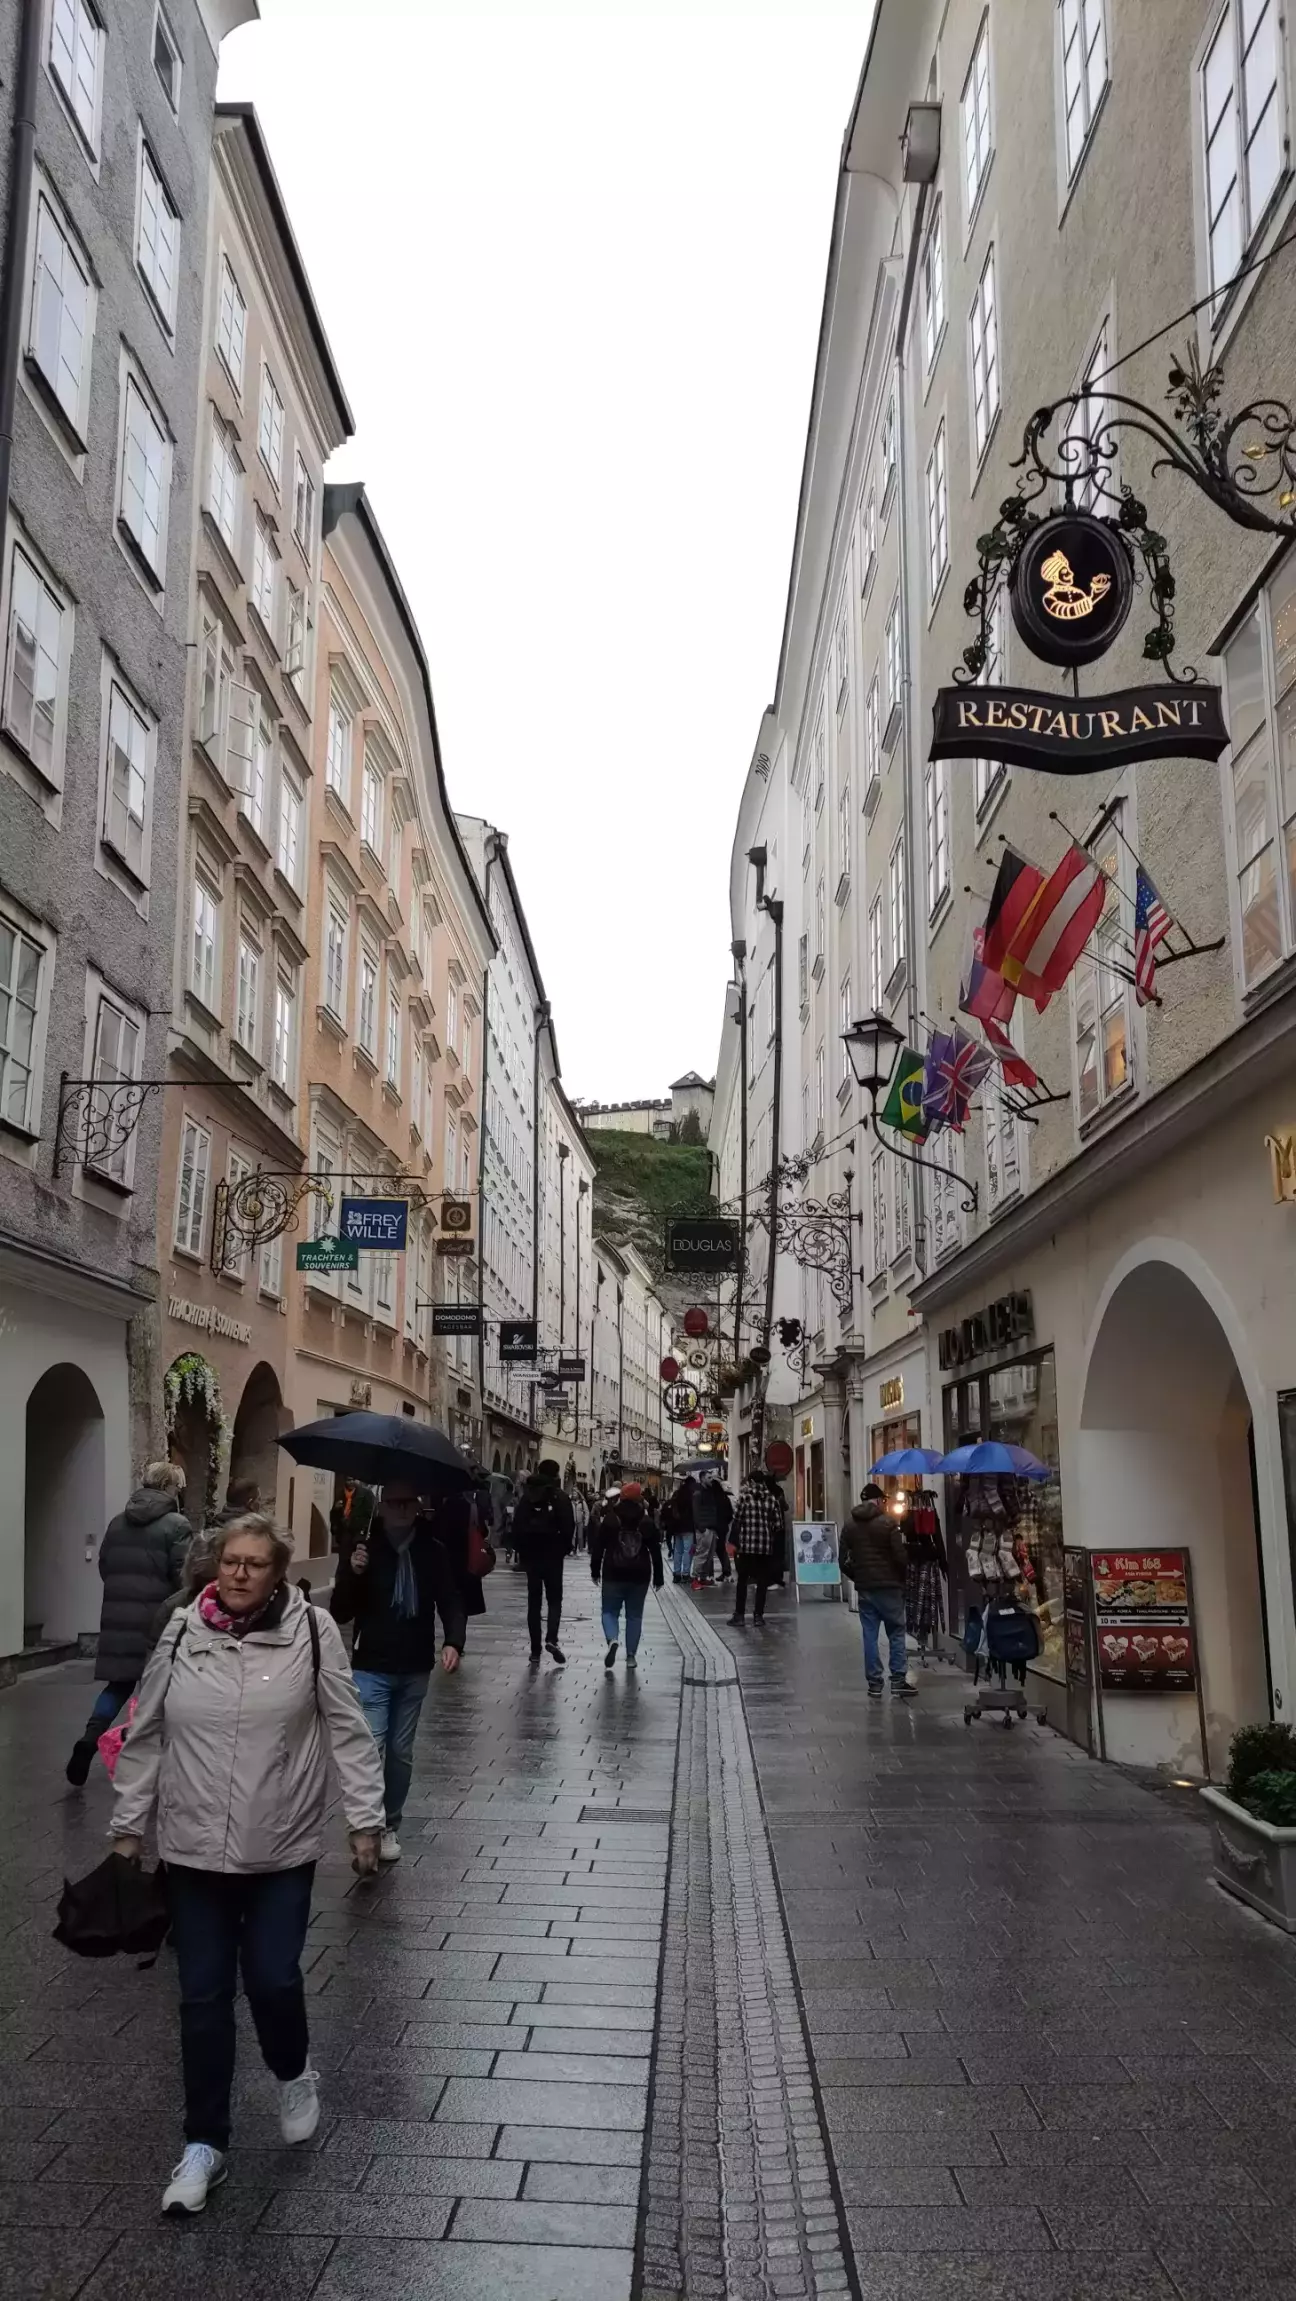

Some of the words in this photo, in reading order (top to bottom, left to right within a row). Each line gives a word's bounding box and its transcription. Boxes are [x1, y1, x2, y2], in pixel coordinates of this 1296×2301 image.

[956, 700, 1207, 740] RESTAURANT
[363, 1213, 403, 1227] FREY
[347, 1225, 398, 1239] WILLE
[673, 1239, 732, 1252] DOUGLAS
[304, 1262, 350, 1270] SOUVENIRS
[168, 1294, 211, 1329] TRACHTEN
[216, 1311, 252, 1344] SOUVENIRS
[1142, 1557, 1162, 1571] 168
